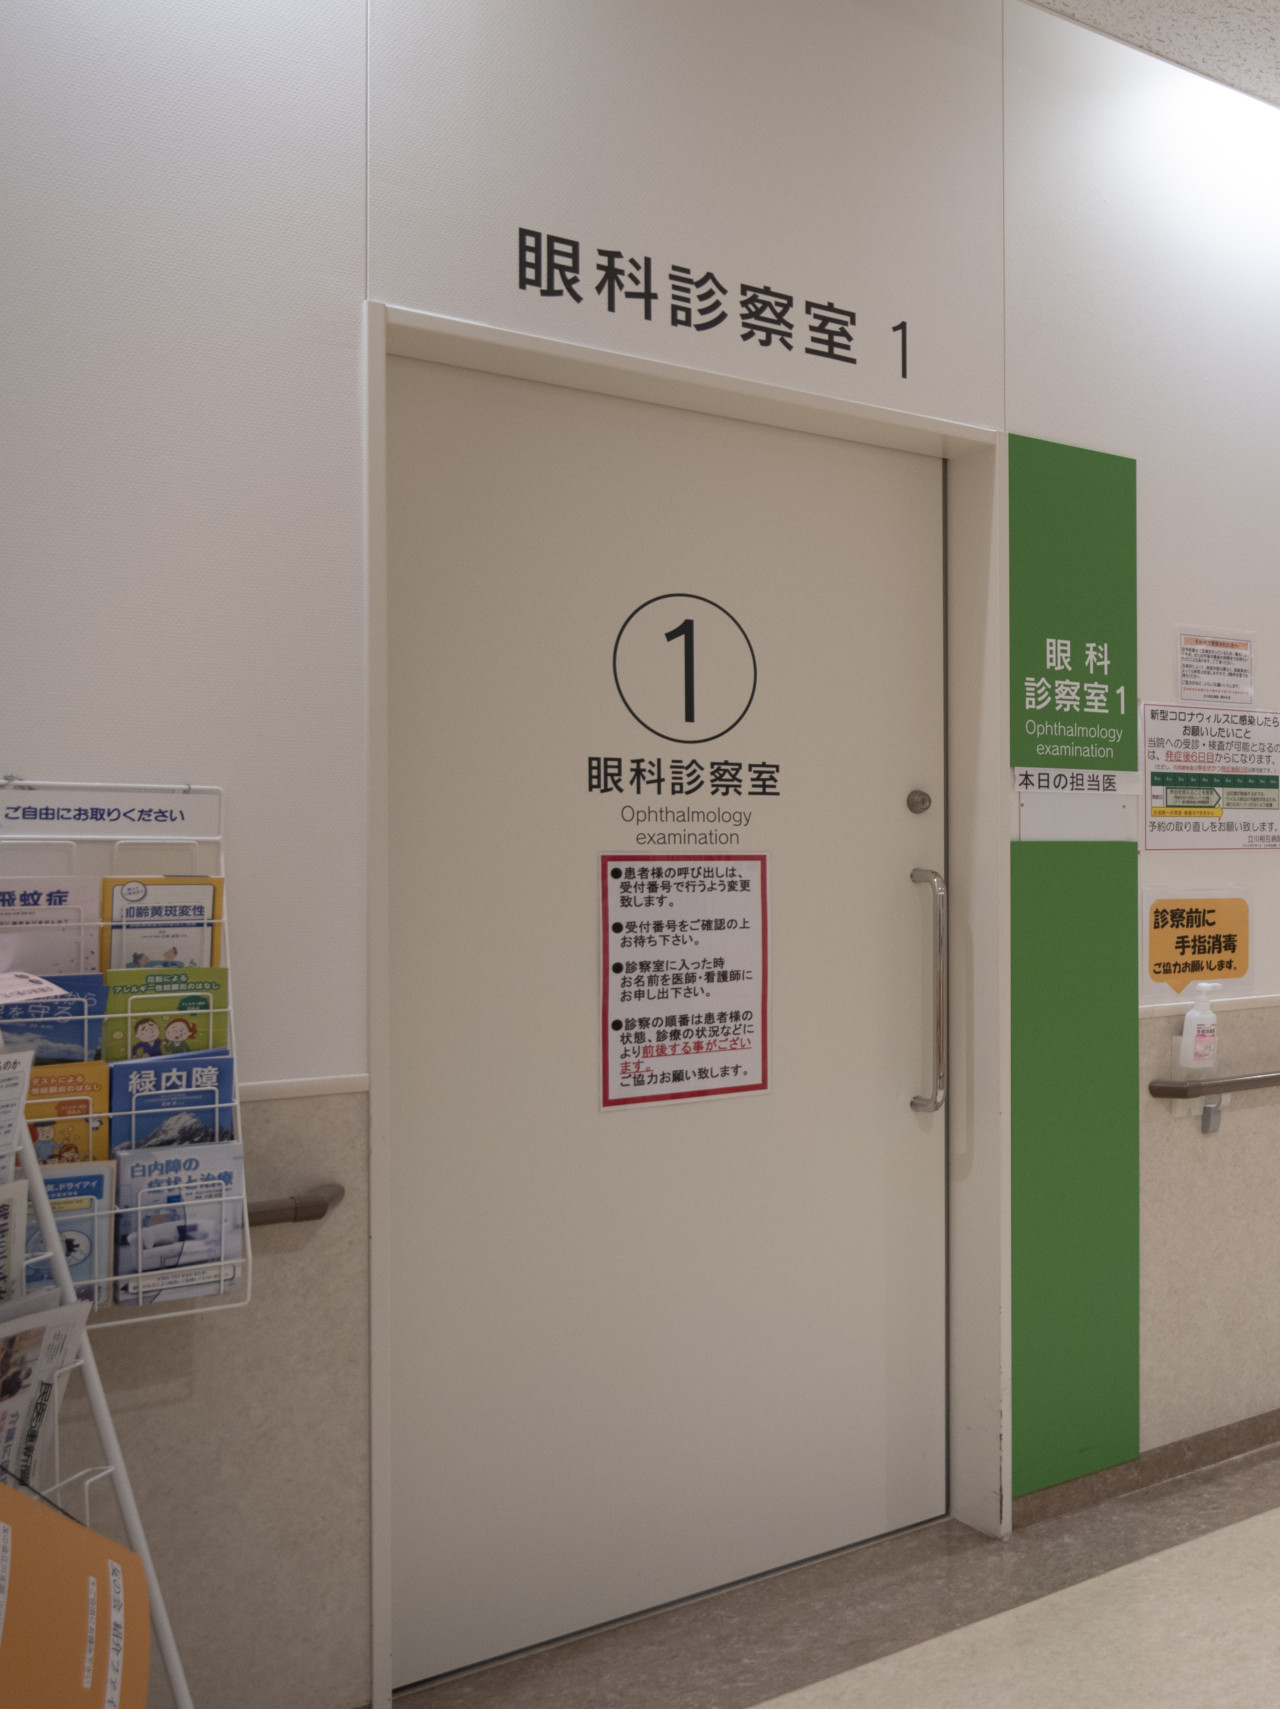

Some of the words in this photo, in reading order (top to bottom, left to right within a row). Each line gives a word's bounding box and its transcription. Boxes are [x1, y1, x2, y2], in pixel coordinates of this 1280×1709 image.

[518, 226, 857, 365] 眼科診察室
[891, 320, 908, 379] 1
[1046, 638, 1110, 675] 眼科
[1024, 677, 1126, 715] 診察室1
[1150, 709, 1280, 728] 新型コロナウィルスに感染したら
[1025, 719, 1123, 743] Ophthalmology
[1182, 725, 1252, 739] お願いしたいこと
[1036, 742, 1114, 758] examination
[1148, 750, 1276, 765] は、発症後6日目からになります。
[588, 756, 780, 797] 眼科診察室
[1018, 771, 1118, 791] 本日の担当医
[4, 805, 186, 823] ご自由にお取りください
[621, 805, 752, 827] Ophthalmology
[1148, 820, 1278, 833] 予約の取り直しをお願い致します。
[636, 829, 740, 845] examination
[624, 866, 744, 880] 患者様の呼び出しは、
[620, 879, 751, 894] 受付番号で行うよう変更
[0, 889, 69, 907] 飛蚊症
[620, 895, 674, 908] 致します。
[625, 918, 751, 934] 受付番号をご確認の上
[1153, 908, 1216, 929] 診察前に
[620, 933, 700, 948] お待ち下さい。
[1174, 933, 1238, 956] 手指消毒
[625, 957, 725, 974] 診察室に入った時
[1152, 959, 1238, 974] ご協力お願いします。
[620, 969, 753, 988] お名前を医師・看護師に
[620, 987, 711, 1003] お申し出下さい。
[624, 1010, 753, 1031] 診察の順番は患者様の
[620, 1024, 754, 1045] 状態、診療の状況などに
[620, 1038, 752, 1059] より前後する事がござい
[619, 1060, 654, 1074] ます。
[620, 1064, 748, 1087] ご協力お願い致します。
[128, 1065, 219, 1094] 緑内障
[130, 1157, 200, 1179] 白内障の
[147, 1170, 234, 1194] 症状と治療
